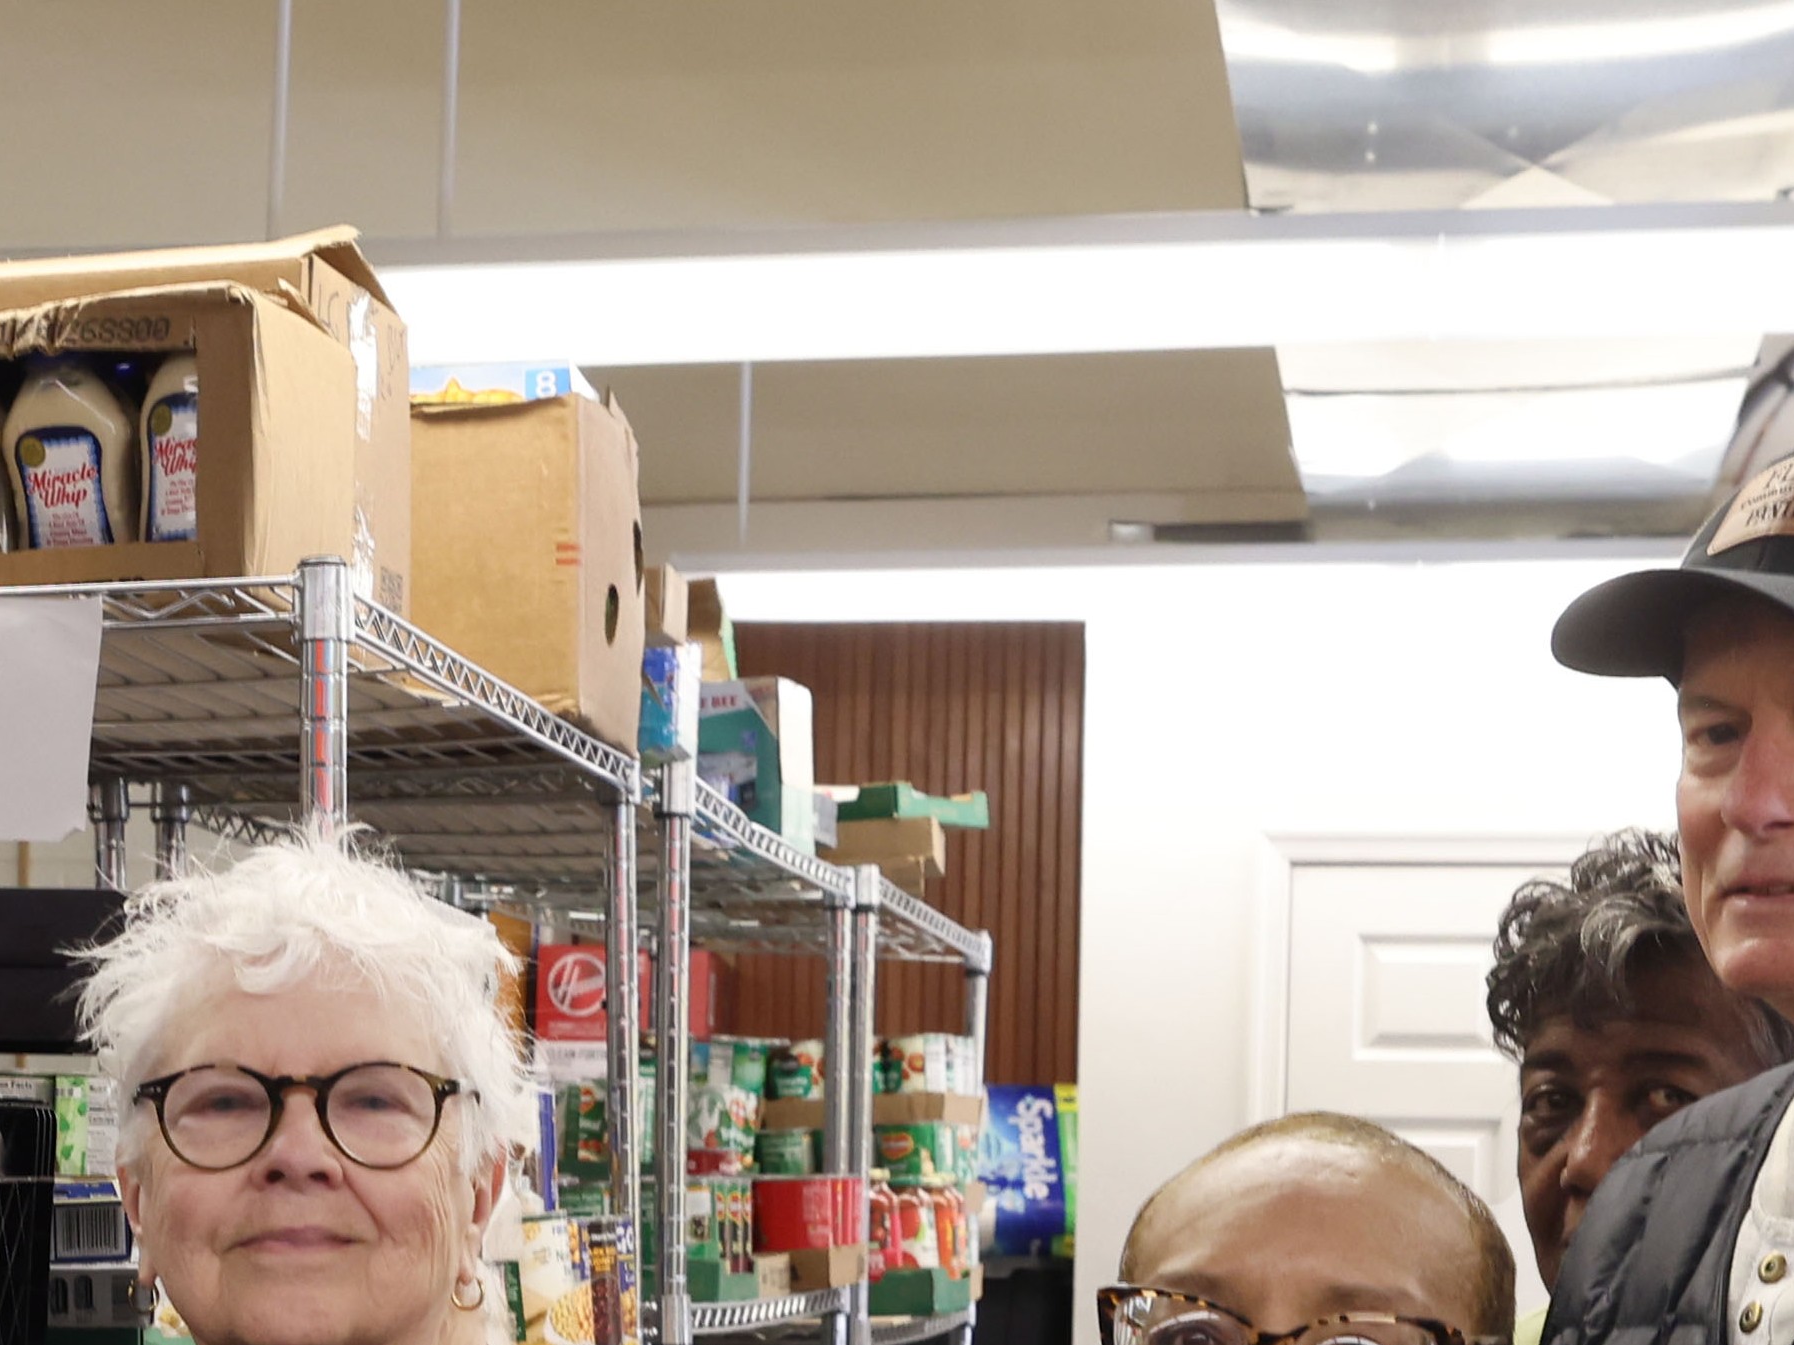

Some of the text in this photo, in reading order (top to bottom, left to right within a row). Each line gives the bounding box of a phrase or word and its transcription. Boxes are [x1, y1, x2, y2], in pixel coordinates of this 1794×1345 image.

[535, 371, 557, 398] 8
[26, 462, 97, 494] Miracle
[40, 484, 87, 508] Whip
[1009, 1094, 1058, 1200] Sparkle
